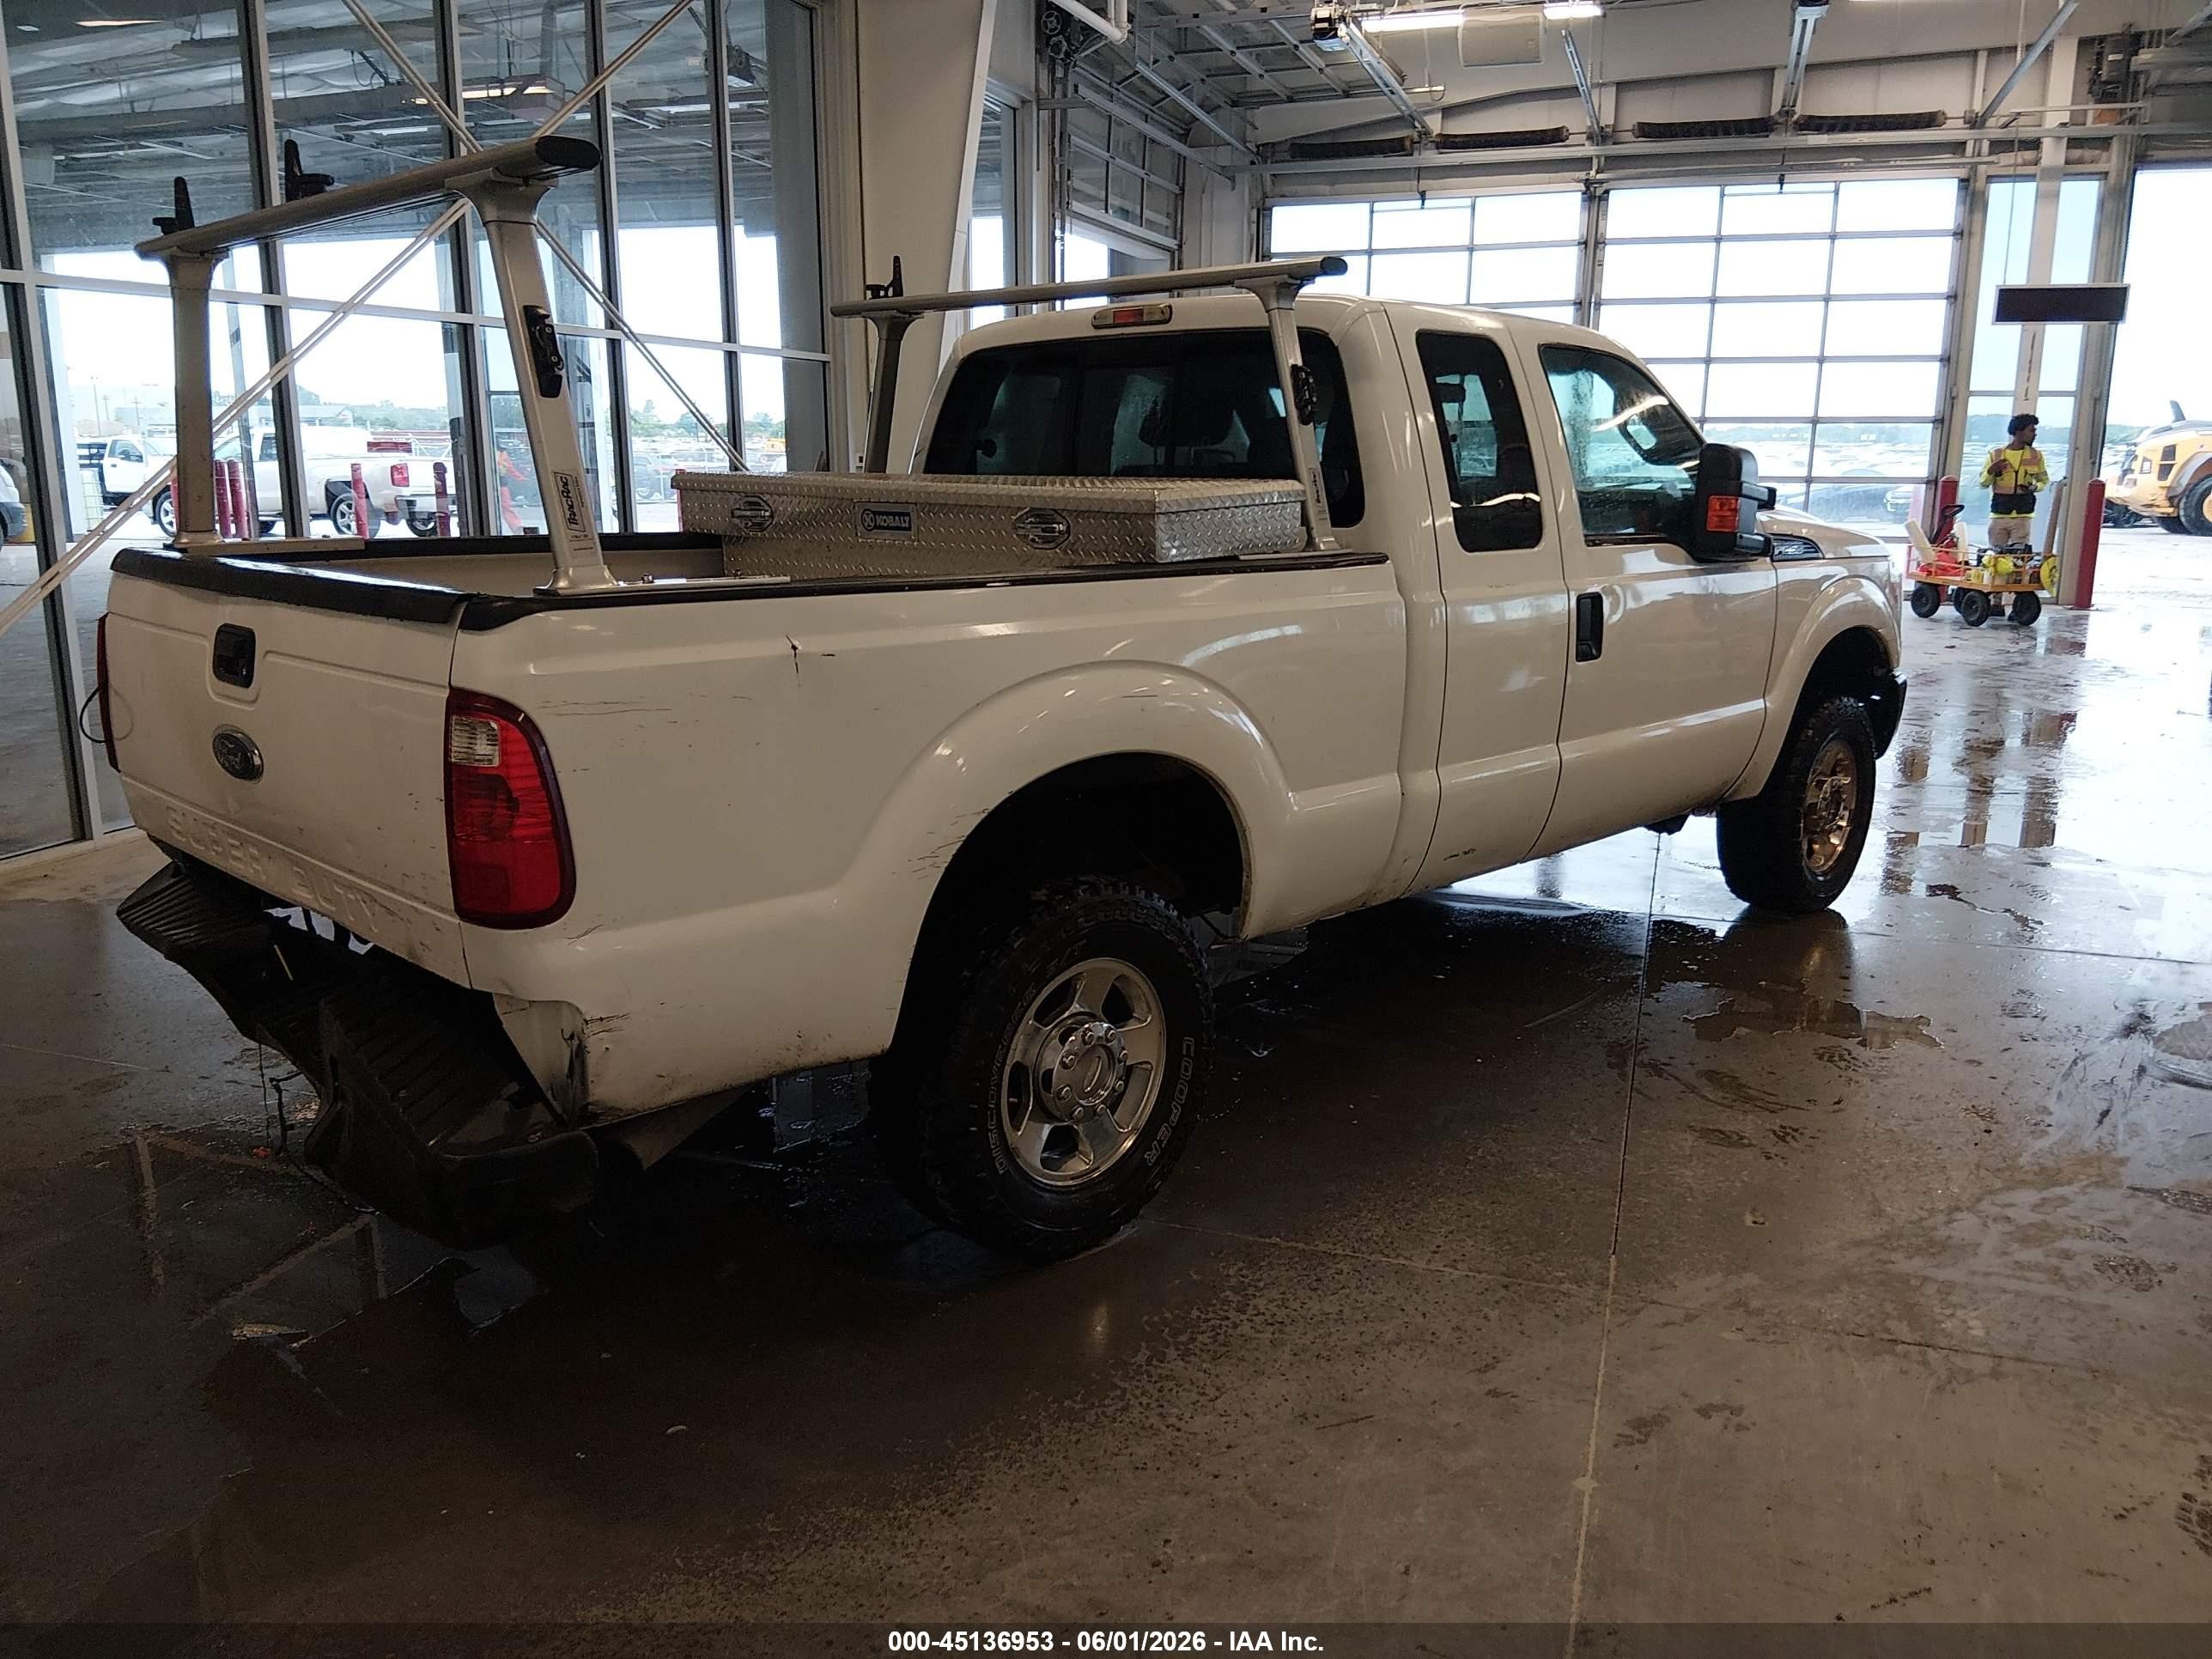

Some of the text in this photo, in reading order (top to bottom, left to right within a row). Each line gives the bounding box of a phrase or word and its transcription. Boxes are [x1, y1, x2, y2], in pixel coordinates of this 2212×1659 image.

[875, 514, 910, 527] KOBALT
[167, 805, 379, 934] SUPER DUTY
[1144, 1036, 1195, 1167] COOPER
